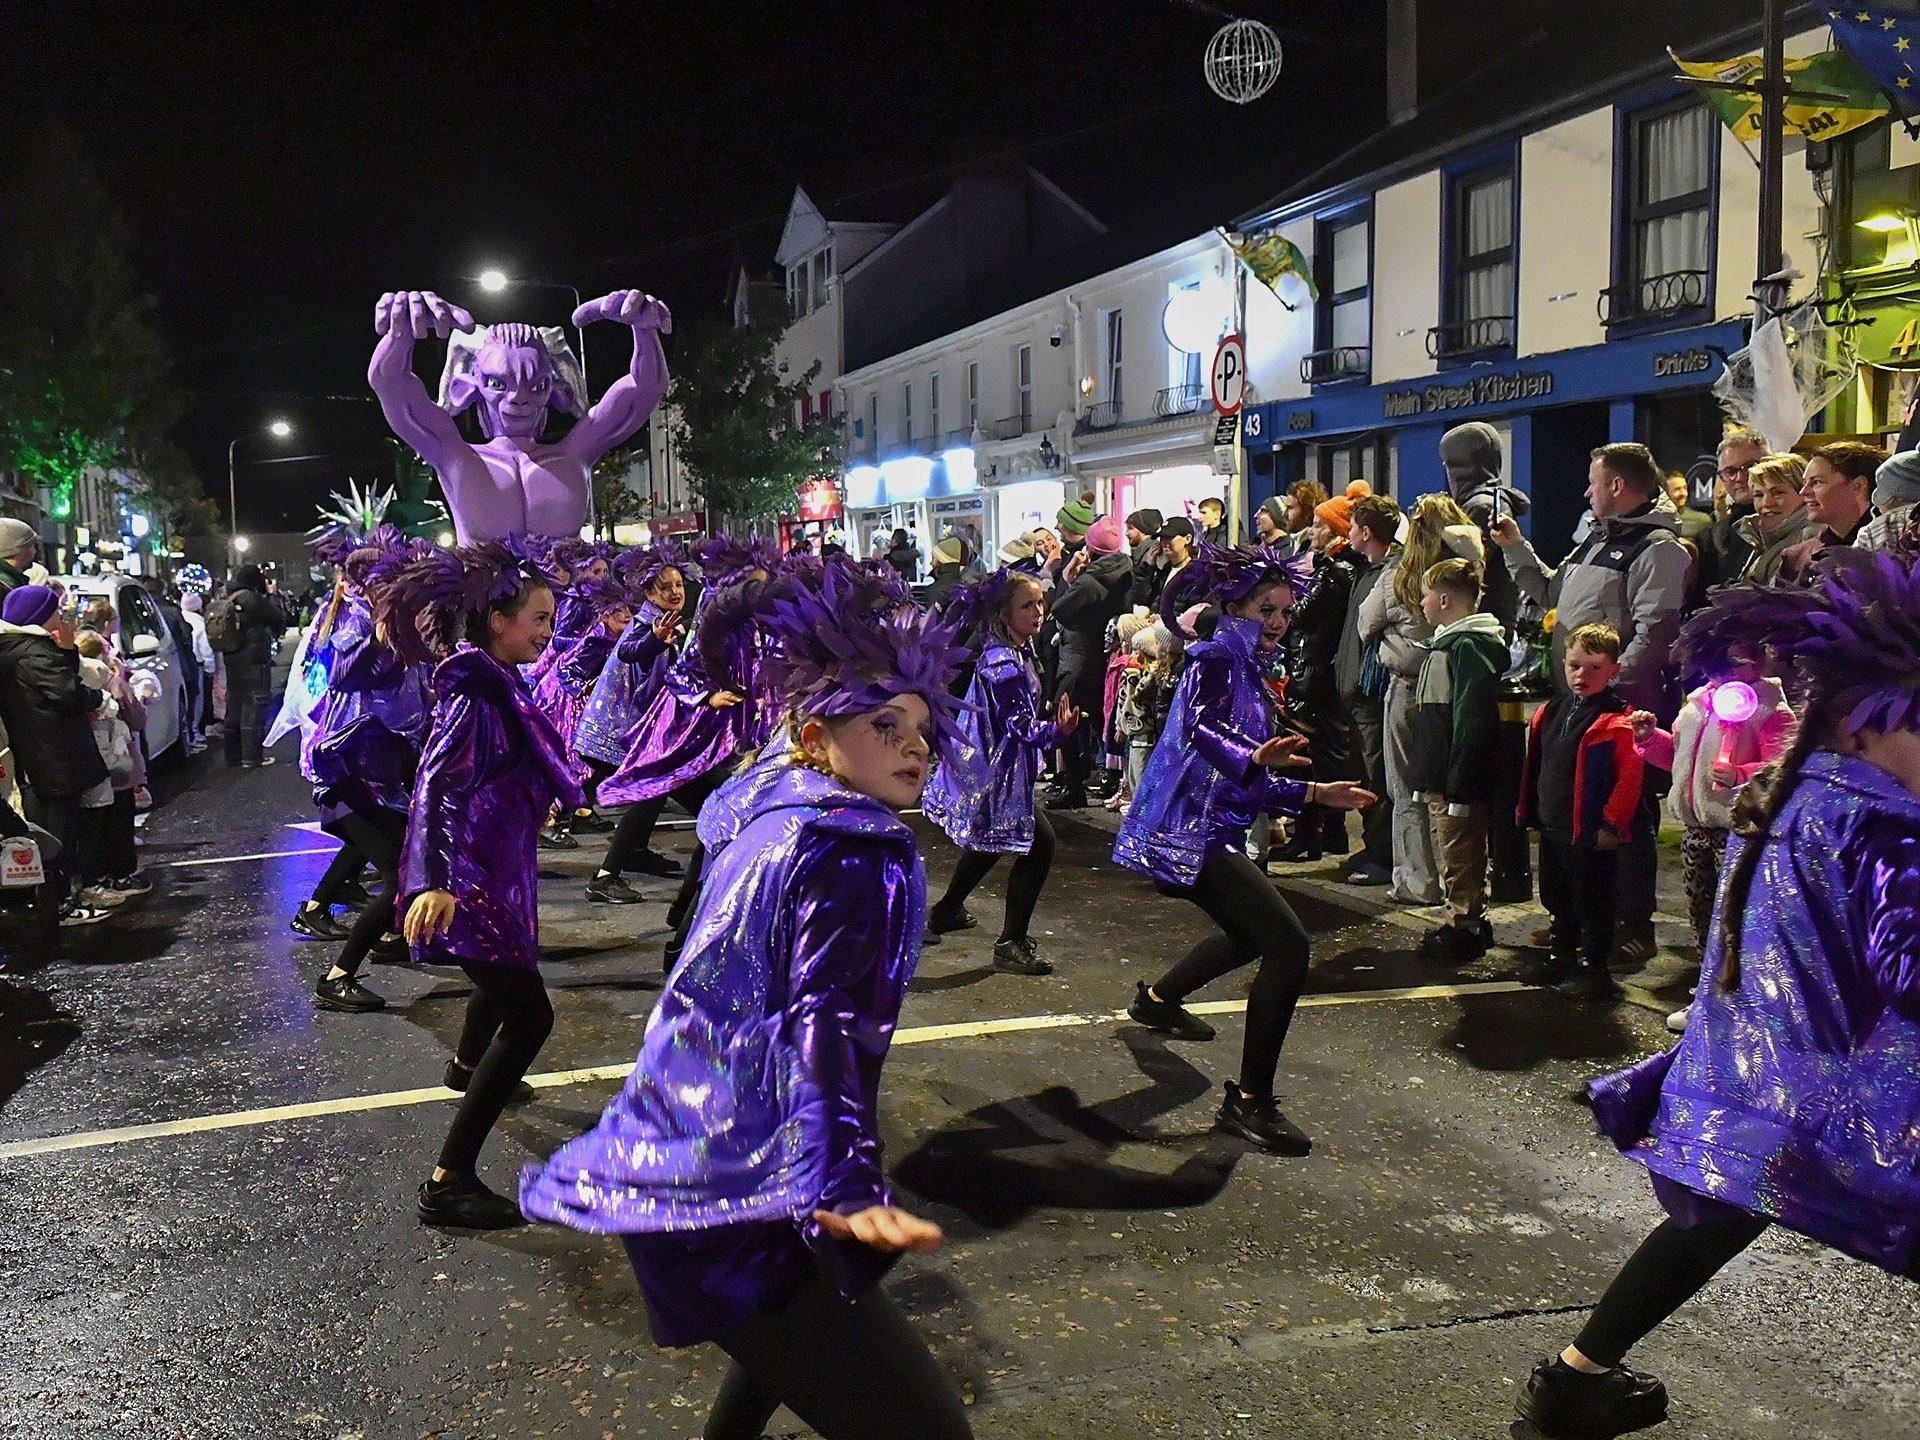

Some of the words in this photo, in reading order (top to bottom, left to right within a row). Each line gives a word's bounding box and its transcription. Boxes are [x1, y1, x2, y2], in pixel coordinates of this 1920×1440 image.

[1890, 318, 1920, 357] 4
[1654, 350, 1709, 377] Drinks
[1385, 390, 1421, 418] Main
[1425, 379, 1475, 412] Street
[1480, 370, 1553, 403] Kitchen
[1245, 413, 1261, 437] 43
[1695, 476, 1714, 499] M
